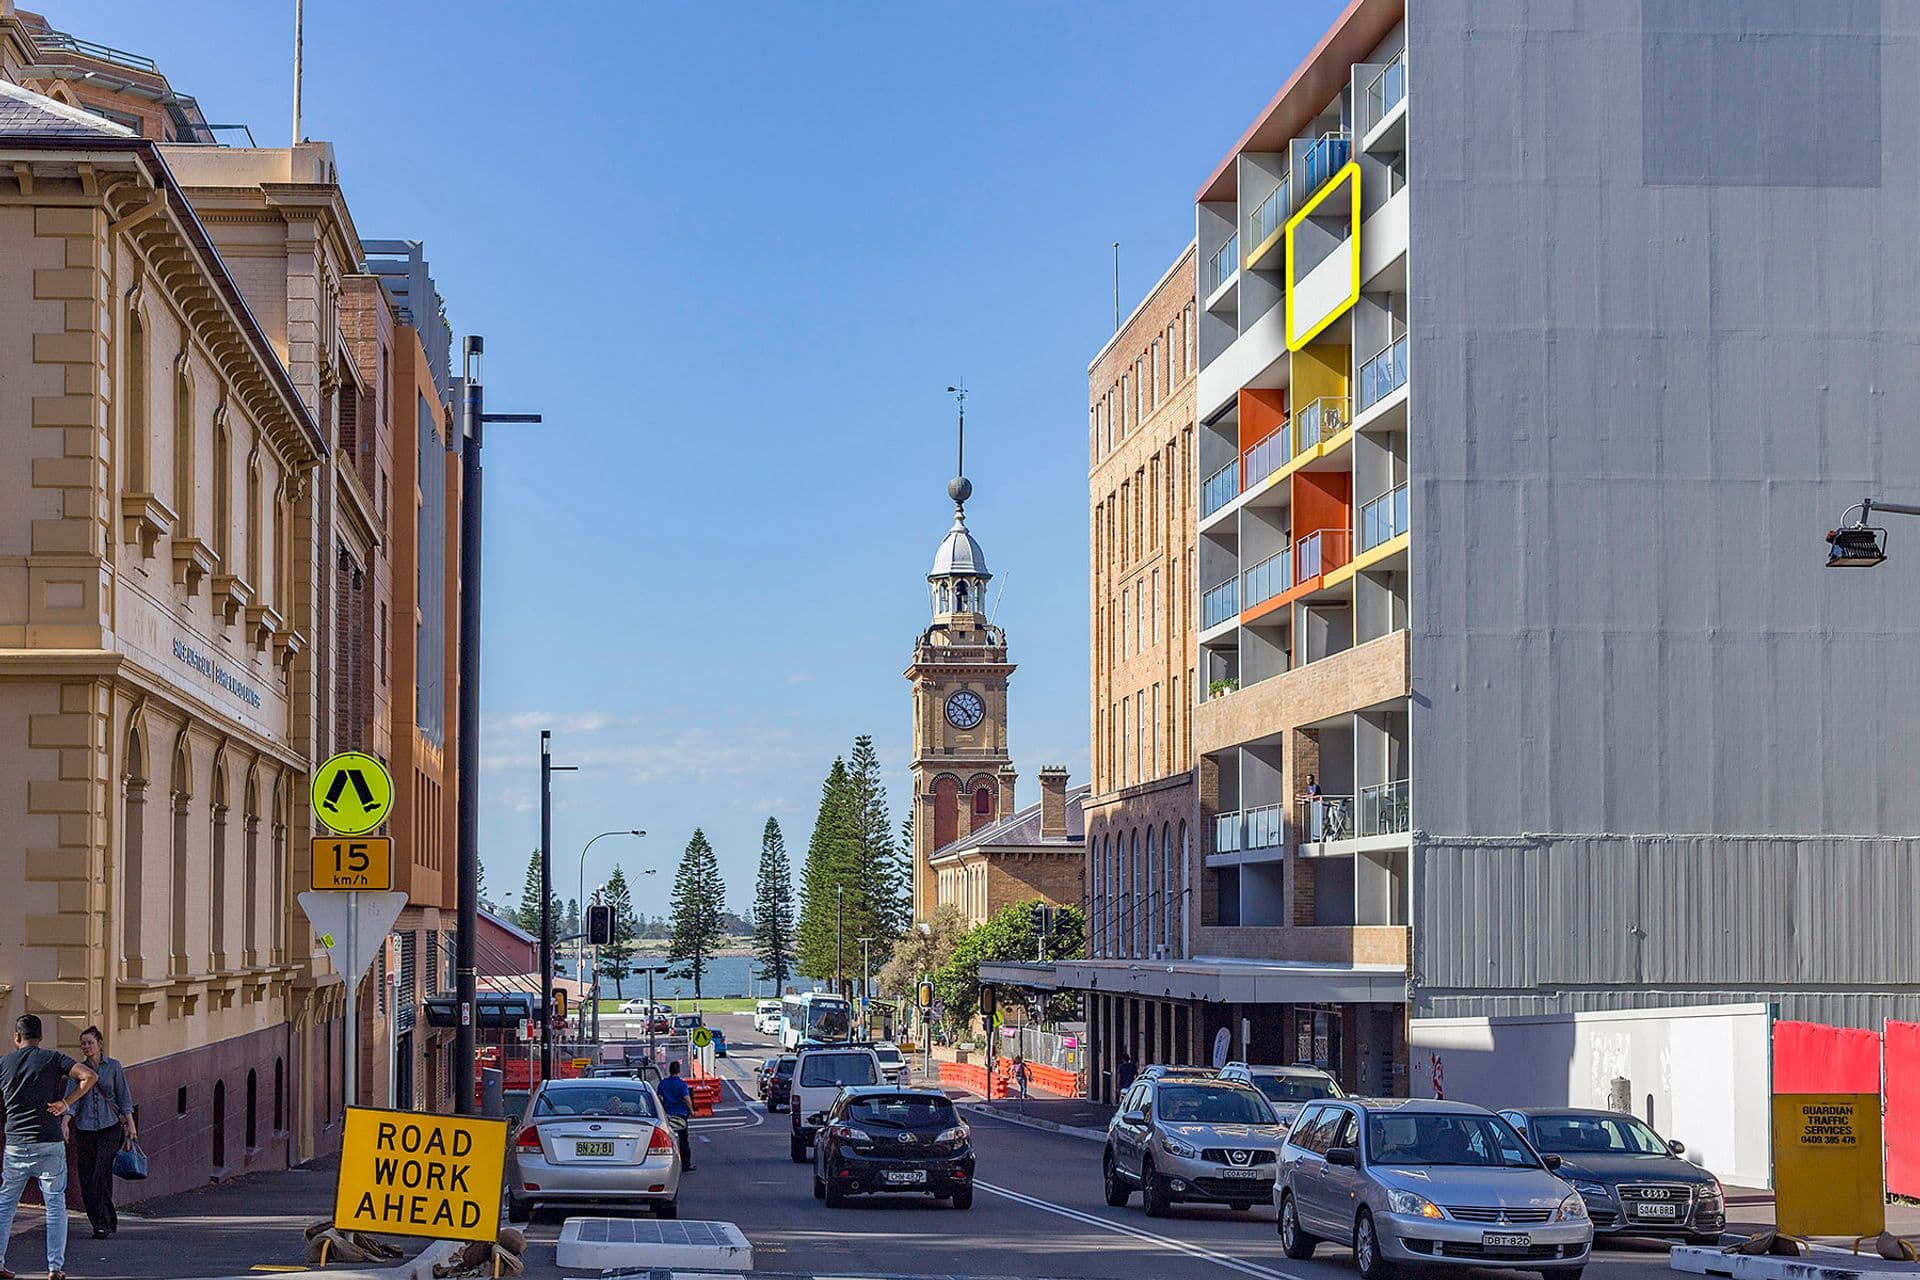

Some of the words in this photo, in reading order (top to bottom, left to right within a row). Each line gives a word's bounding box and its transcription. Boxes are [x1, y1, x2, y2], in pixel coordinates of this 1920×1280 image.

[332, 844, 370, 872] 15
[333, 875, 368, 885] km/h
[1802, 1106, 1853, 1115] GUARDIAN
[1807, 1116, 1849, 1125] TRAFFIC
[1804, 1126, 1853, 1135] SERVICES
[376, 1122, 473, 1157] ROAD
[1801, 1136, 1822, 1144] 0409
[375, 1157, 471, 1193] WORK
[353, 1192, 481, 1228] AHEAD
